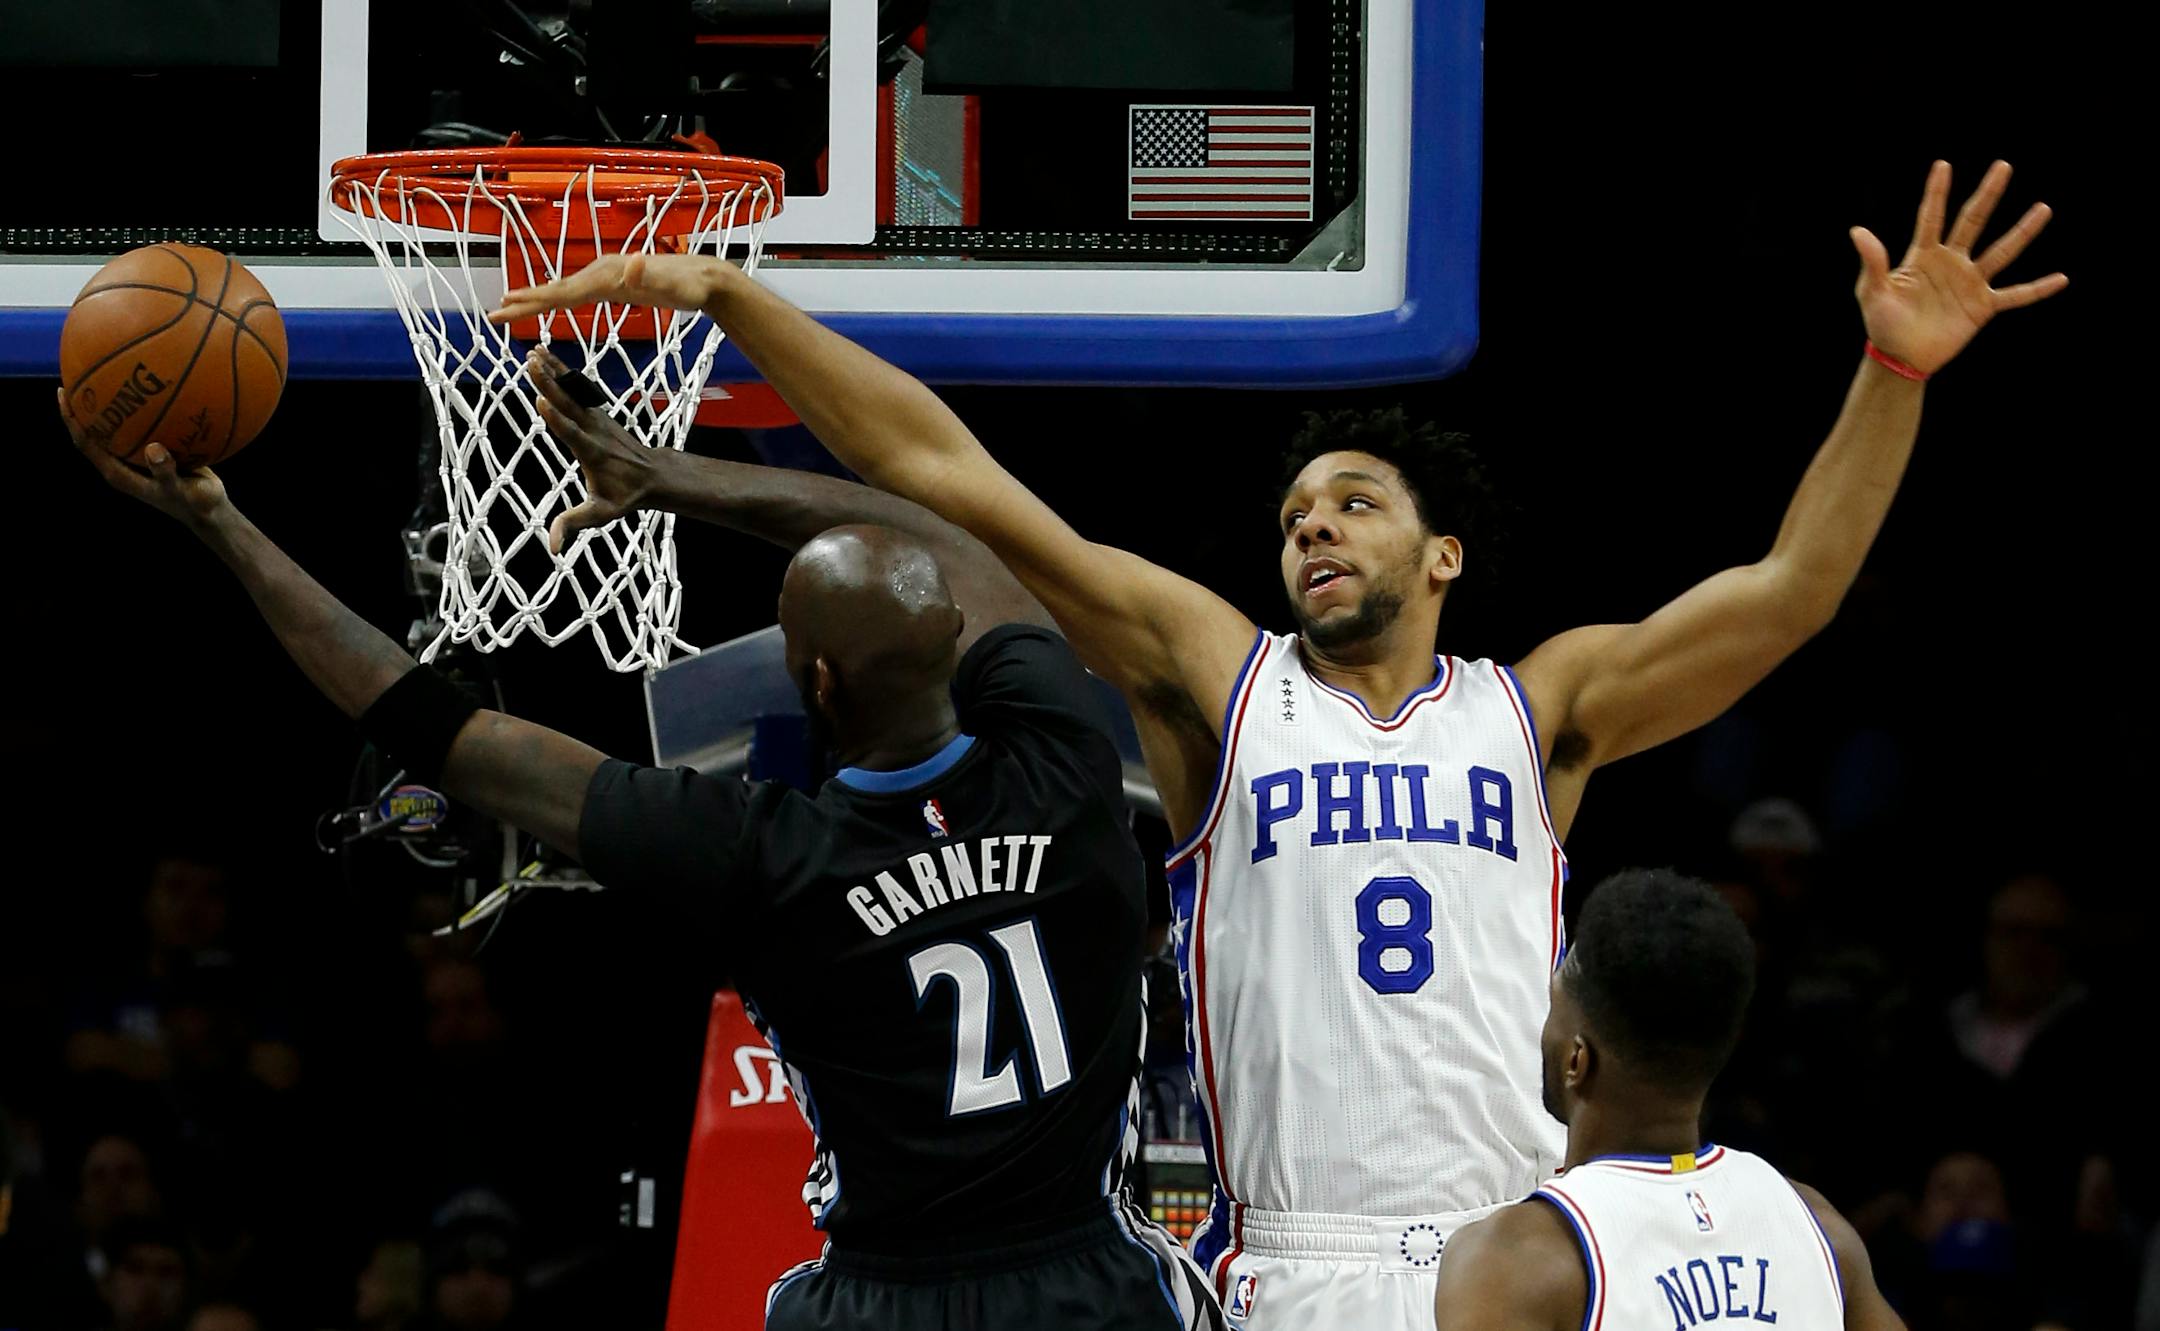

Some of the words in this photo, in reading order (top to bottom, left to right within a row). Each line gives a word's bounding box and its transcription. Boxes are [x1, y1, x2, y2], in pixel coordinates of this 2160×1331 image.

[1251, 761, 1518, 865] PHILA
[846, 835, 1052, 936] GARNETT
[1355, 876, 1434, 995] 8
[906, 917, 1073, 1117] 21
[1655, 1255, 1777, 1331] NOEL
